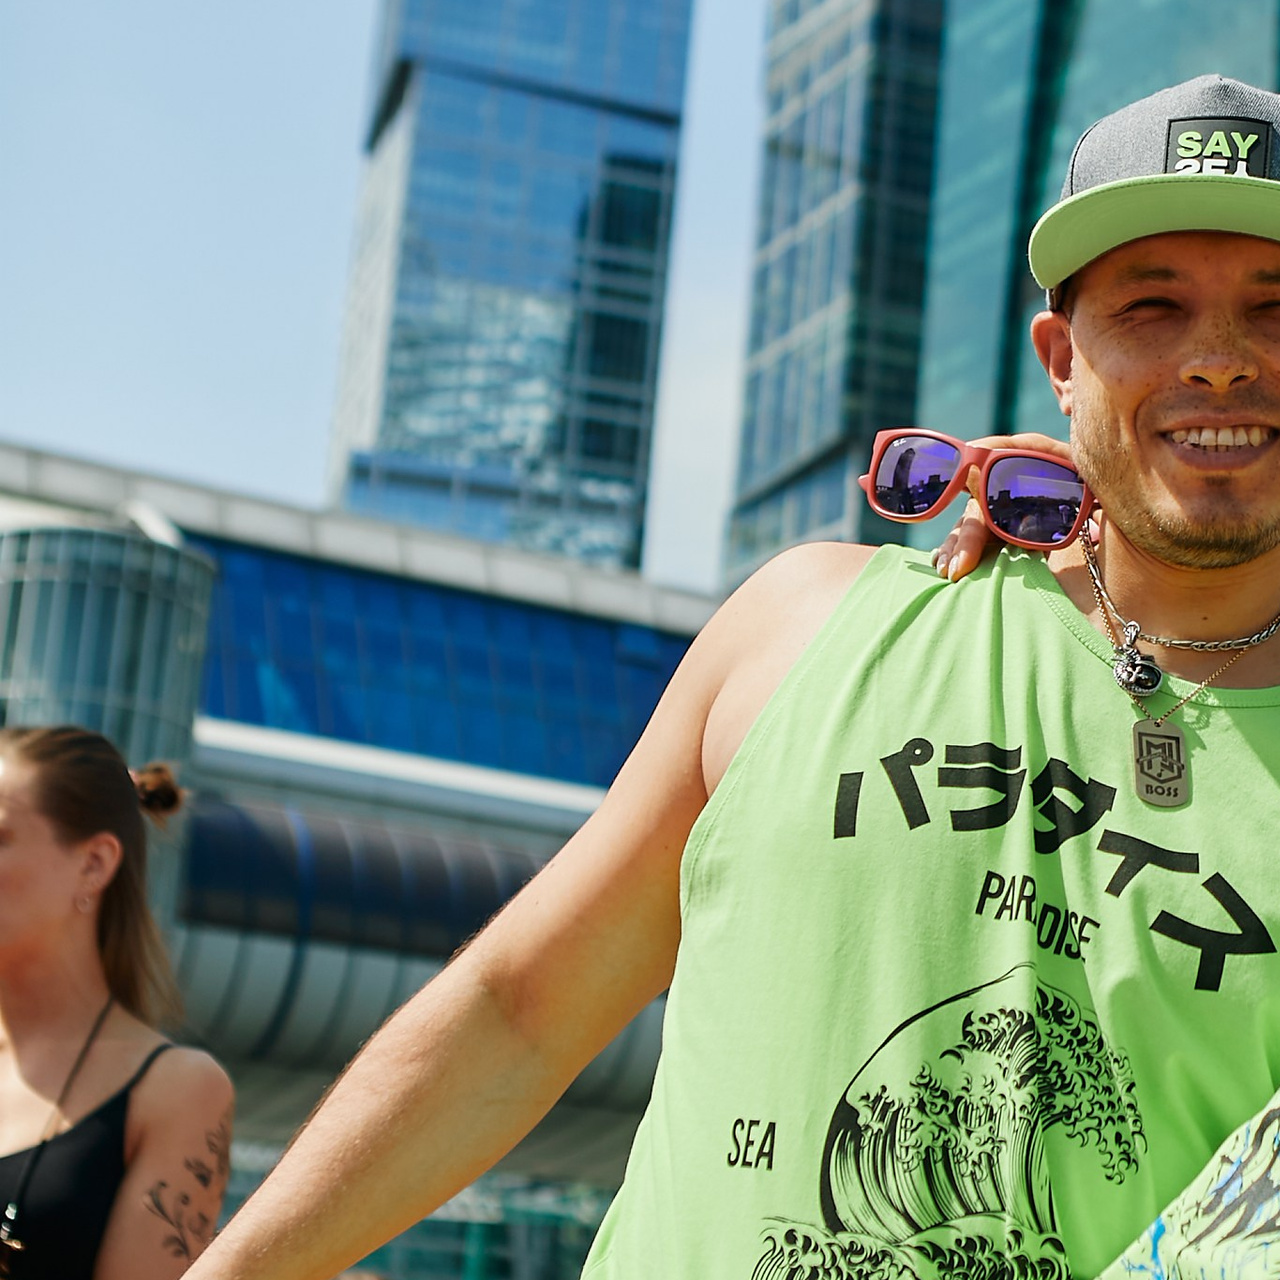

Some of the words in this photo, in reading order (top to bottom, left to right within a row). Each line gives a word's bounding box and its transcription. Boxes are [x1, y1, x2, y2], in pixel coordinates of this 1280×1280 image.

[1176, 131, 1258, 159] SAY
[1145, 784, 1179, 798] BOSS
[975, 869, 1101, 964] PARDISE
[727, 1118, 776, 1171] SEA
